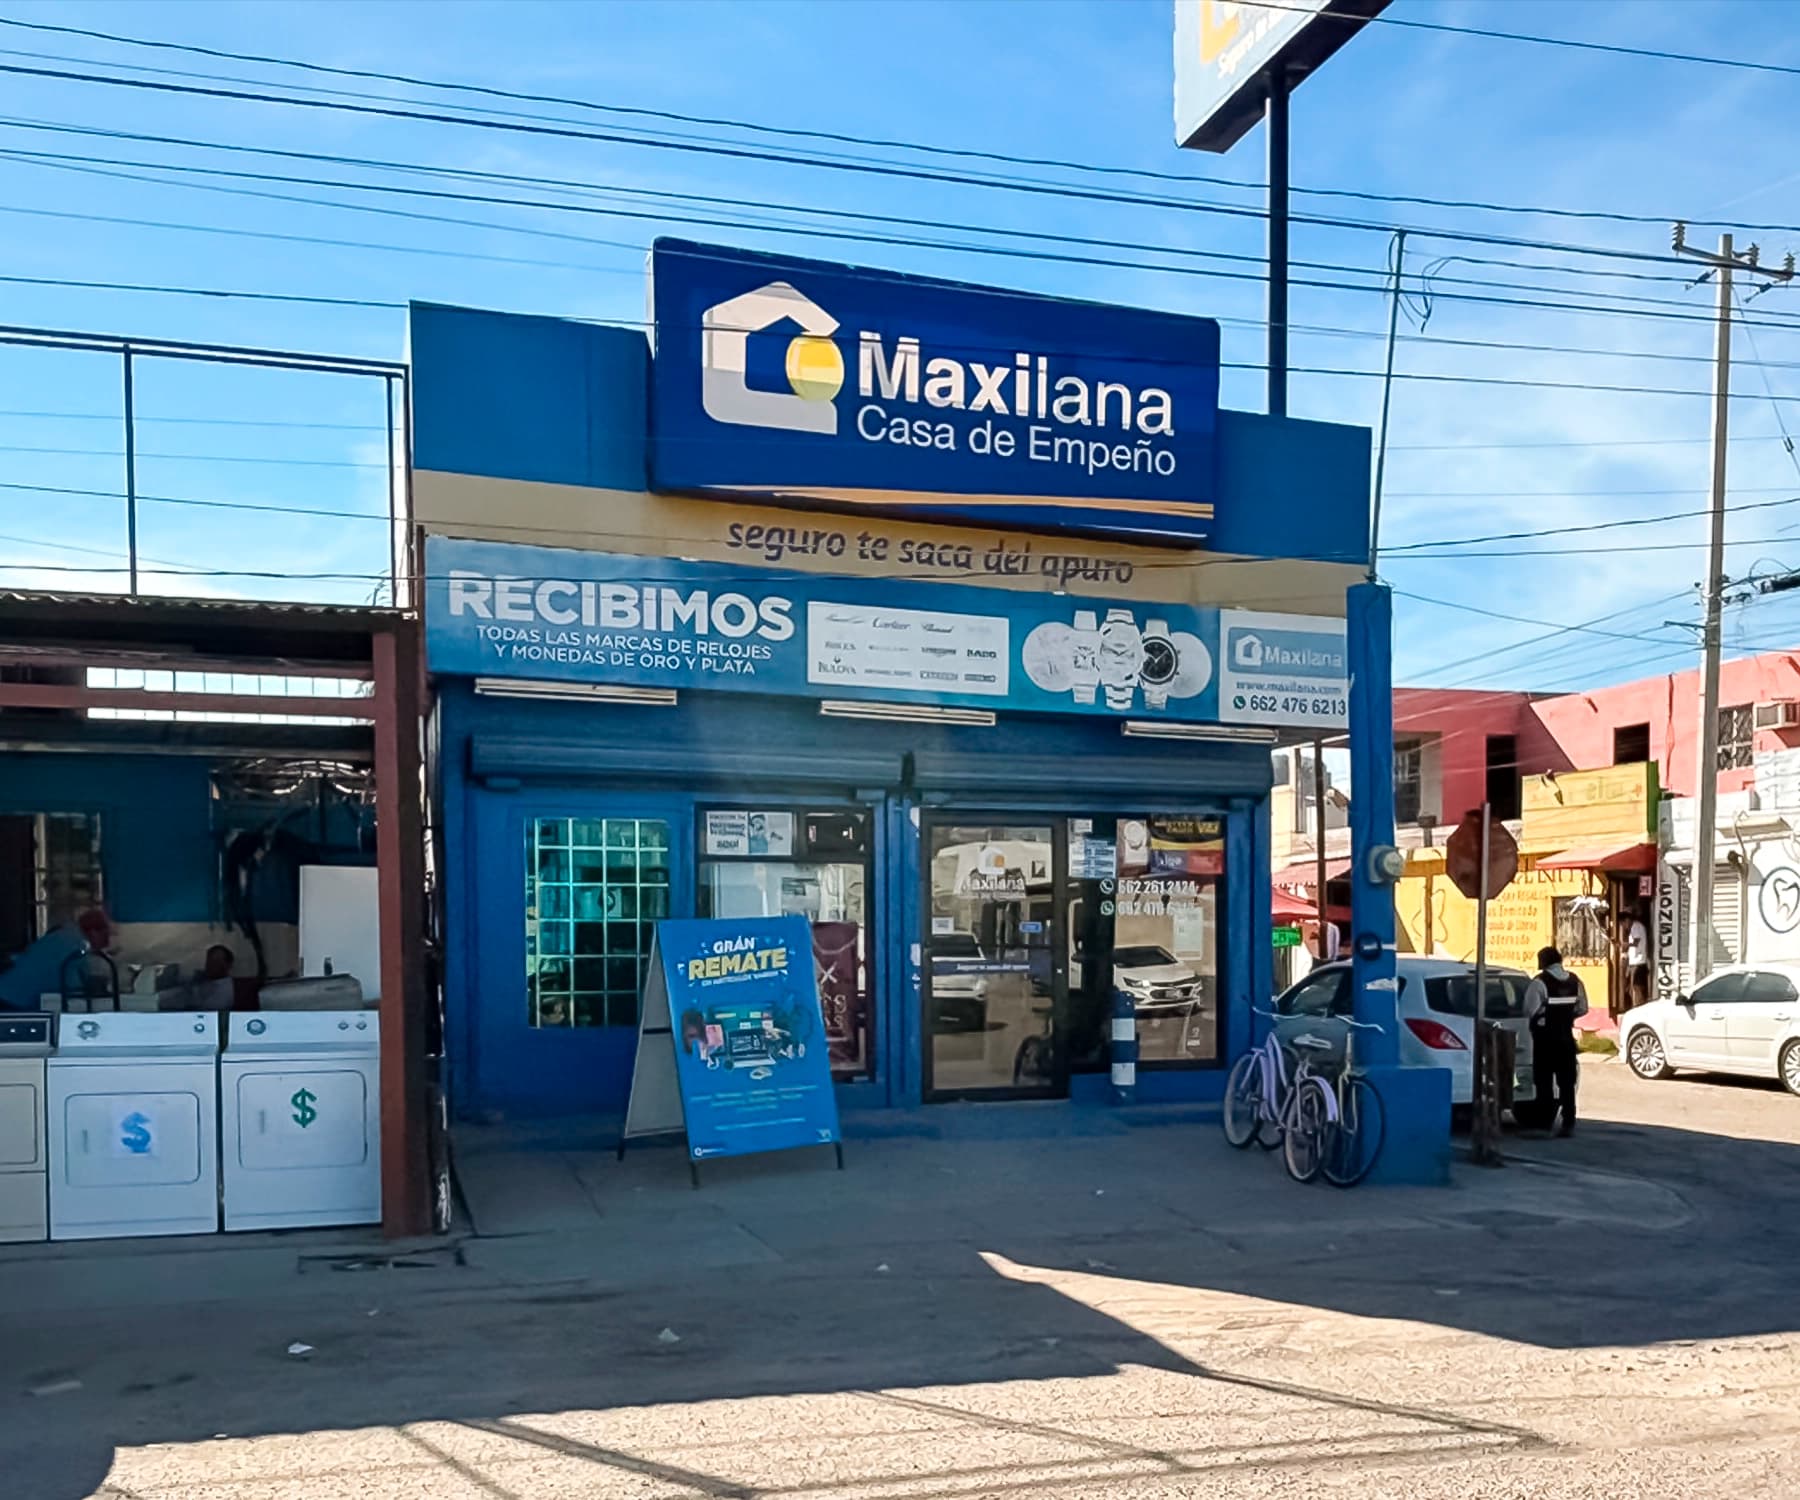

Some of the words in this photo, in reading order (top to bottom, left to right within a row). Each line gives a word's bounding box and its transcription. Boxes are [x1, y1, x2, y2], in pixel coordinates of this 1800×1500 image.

[858, 330, 1175, 437] Maxilana
[856, 405, 956, 451] Casa
[968, 420, 1016, 456] de
[1029, 425, 1176, 476] Empeño
[727, 521, 847, 561] seguro
[858, 531, 888, 562] te
[898, 540, 973, 571] saca
[983, 539, 1030, 574] del
[1041, 554, 1134, 588] apuro
[448, 569, 796, 642] RECIBIMOS
[476, 624, 541, 644] TODAS
[544, 631, 581, 646] LAS
[585, 634, 662, 652] MARCAS
[668, 639, 693, 655] DE
[697, 643, 773, 661] RELOJES
[494, 643, 505, 657] Y
[511, 644, 606, 665] MONEDAS
[610, 651, 636, 667] DE
[638, 653, 682, 670] ORO
[685, 656, 697, 670] Y
[701, 658, 756, 676] PLATA
[1264, 646, 1343, 668] Maxilana
[1250, 694, 1278, 712] 662
[1312, 698, 1347, 716] 6213
[688, 947, 789, 980] REMATE
